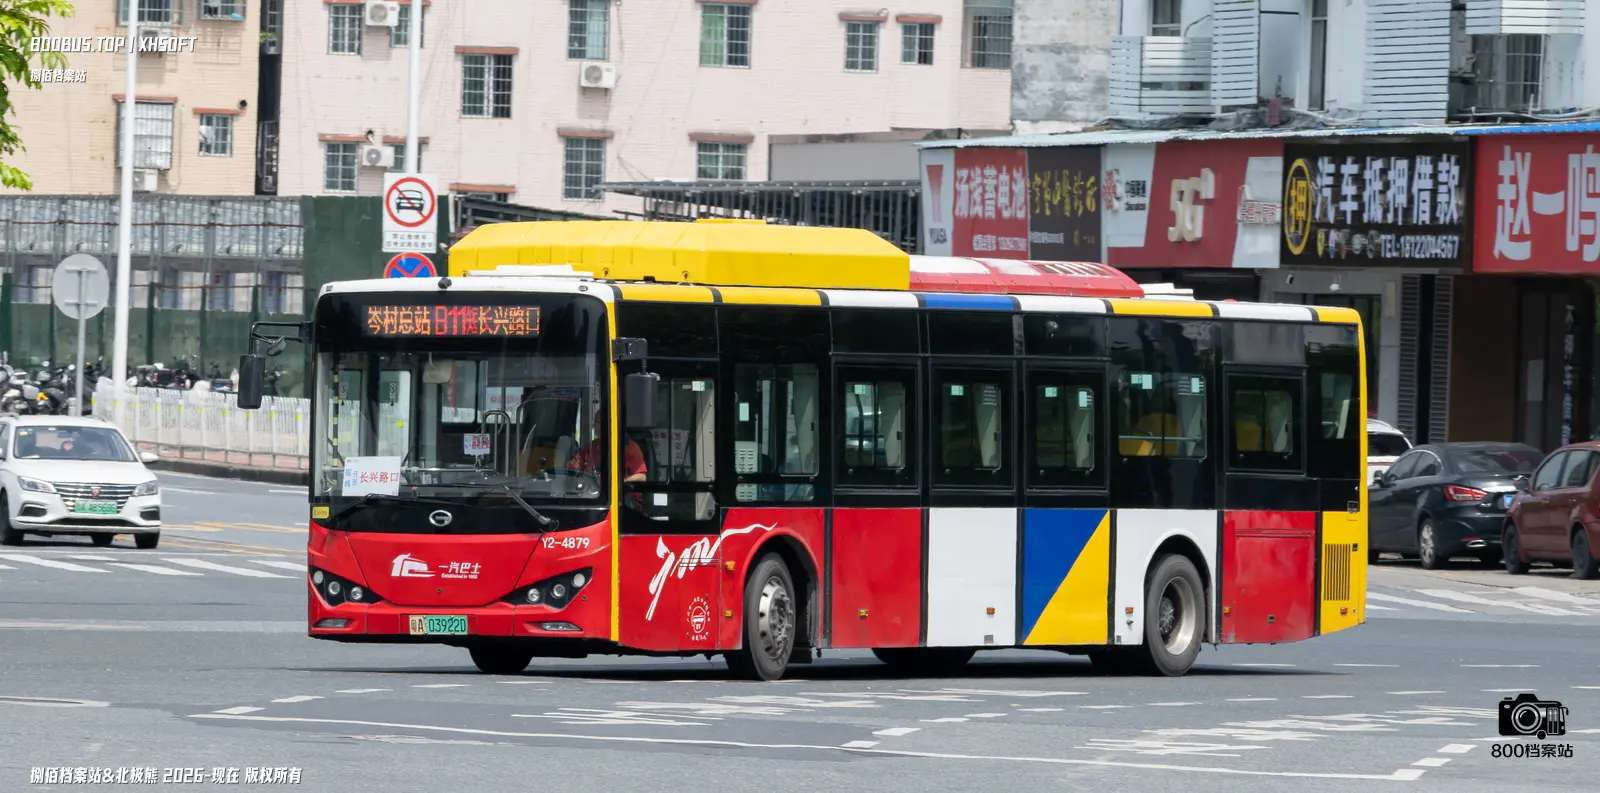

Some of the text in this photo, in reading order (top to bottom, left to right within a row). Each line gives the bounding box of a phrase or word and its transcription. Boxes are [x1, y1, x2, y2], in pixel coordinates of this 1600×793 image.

[955, 164, 1025, 219] 汤浅蓄电池
[1315, 154, 1461, 226] 汽车抵押借款
[1290, 177, 1307, 236] 押
[367, 305, 431, 335] 岑村总站
[478, 305, 540, 335] 长兴路口
[359, 471, 399, 484] 长兴路口
[542, 537, 590, 549] Y2-4879
[438, 561, 482, 575] 一汽巴士
